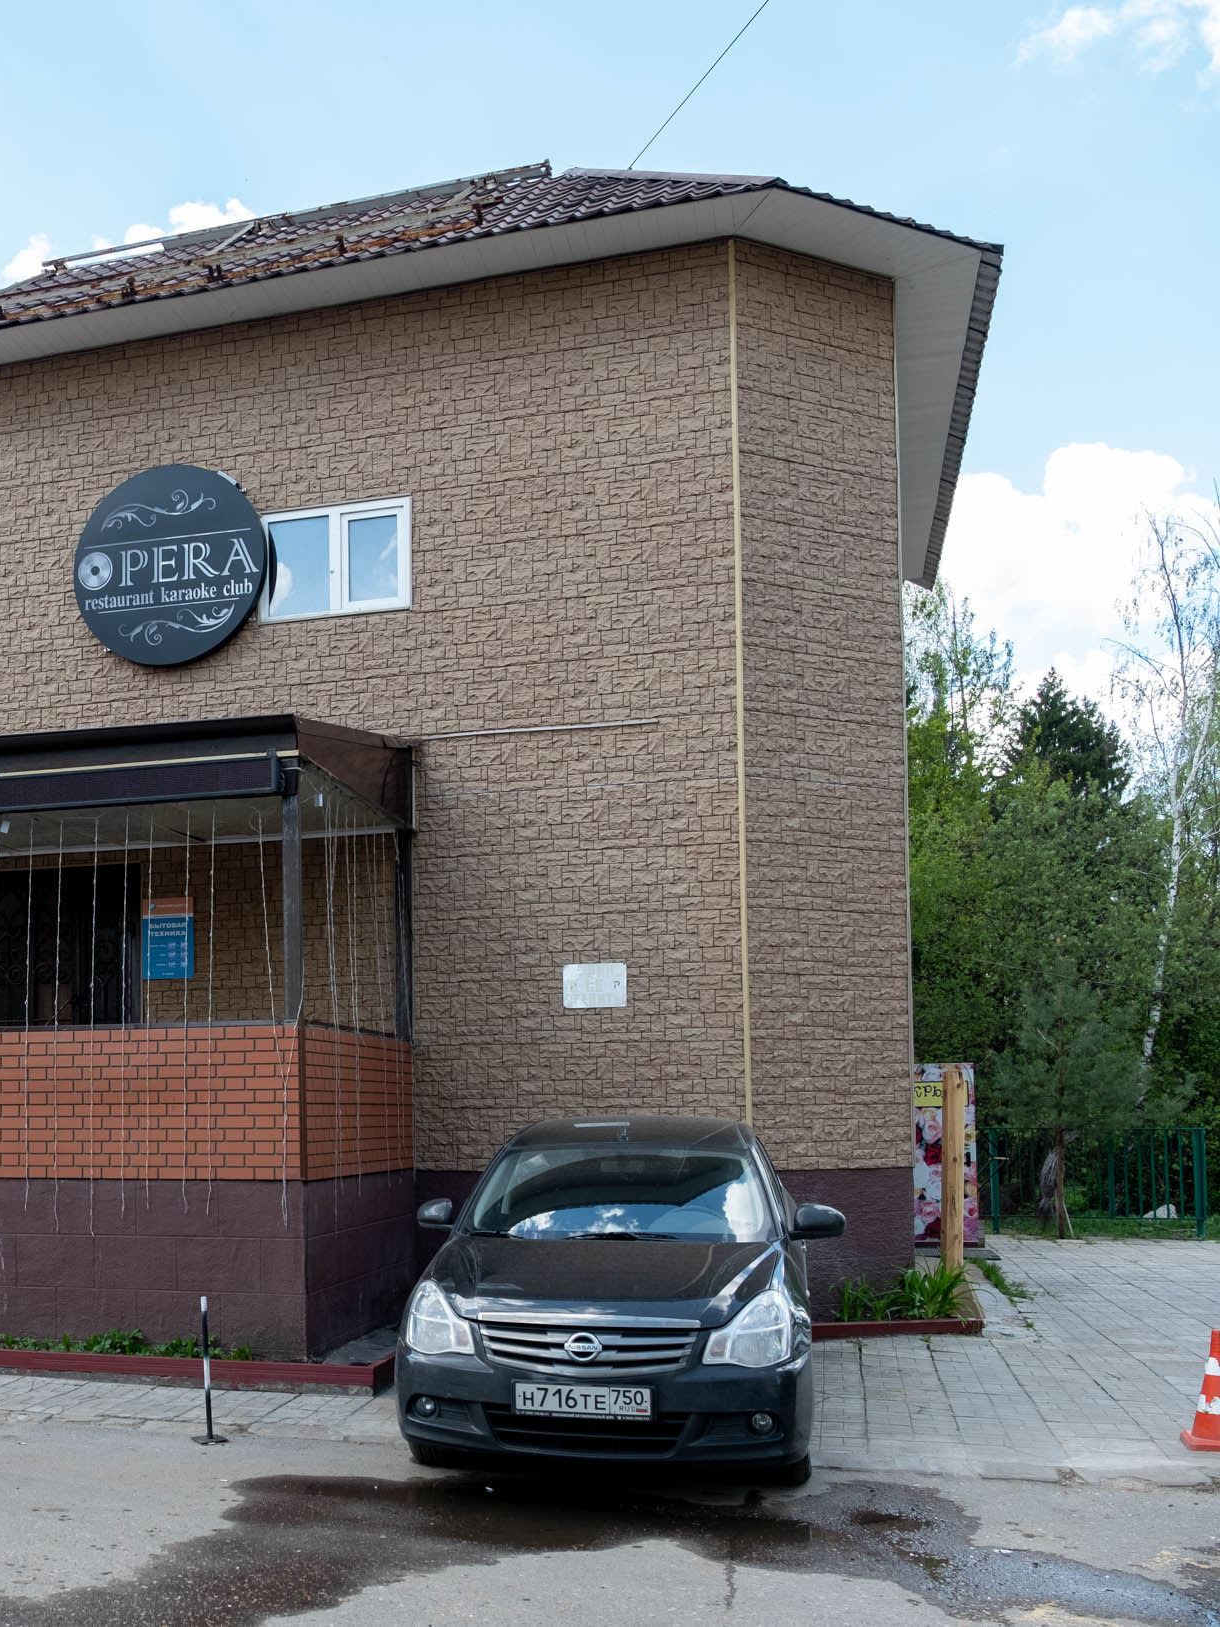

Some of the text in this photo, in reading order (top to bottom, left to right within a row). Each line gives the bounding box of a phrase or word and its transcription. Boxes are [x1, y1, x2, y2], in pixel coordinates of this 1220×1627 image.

[78, 537, 260, 591] OPERA
[84, 578, 253, 611] restaurant karaoke club
[568, 1343, 598, 1351] NISSAN
[611, 1389, 645, 1406] 750
[619, 1405, 636, 1413] RUS
